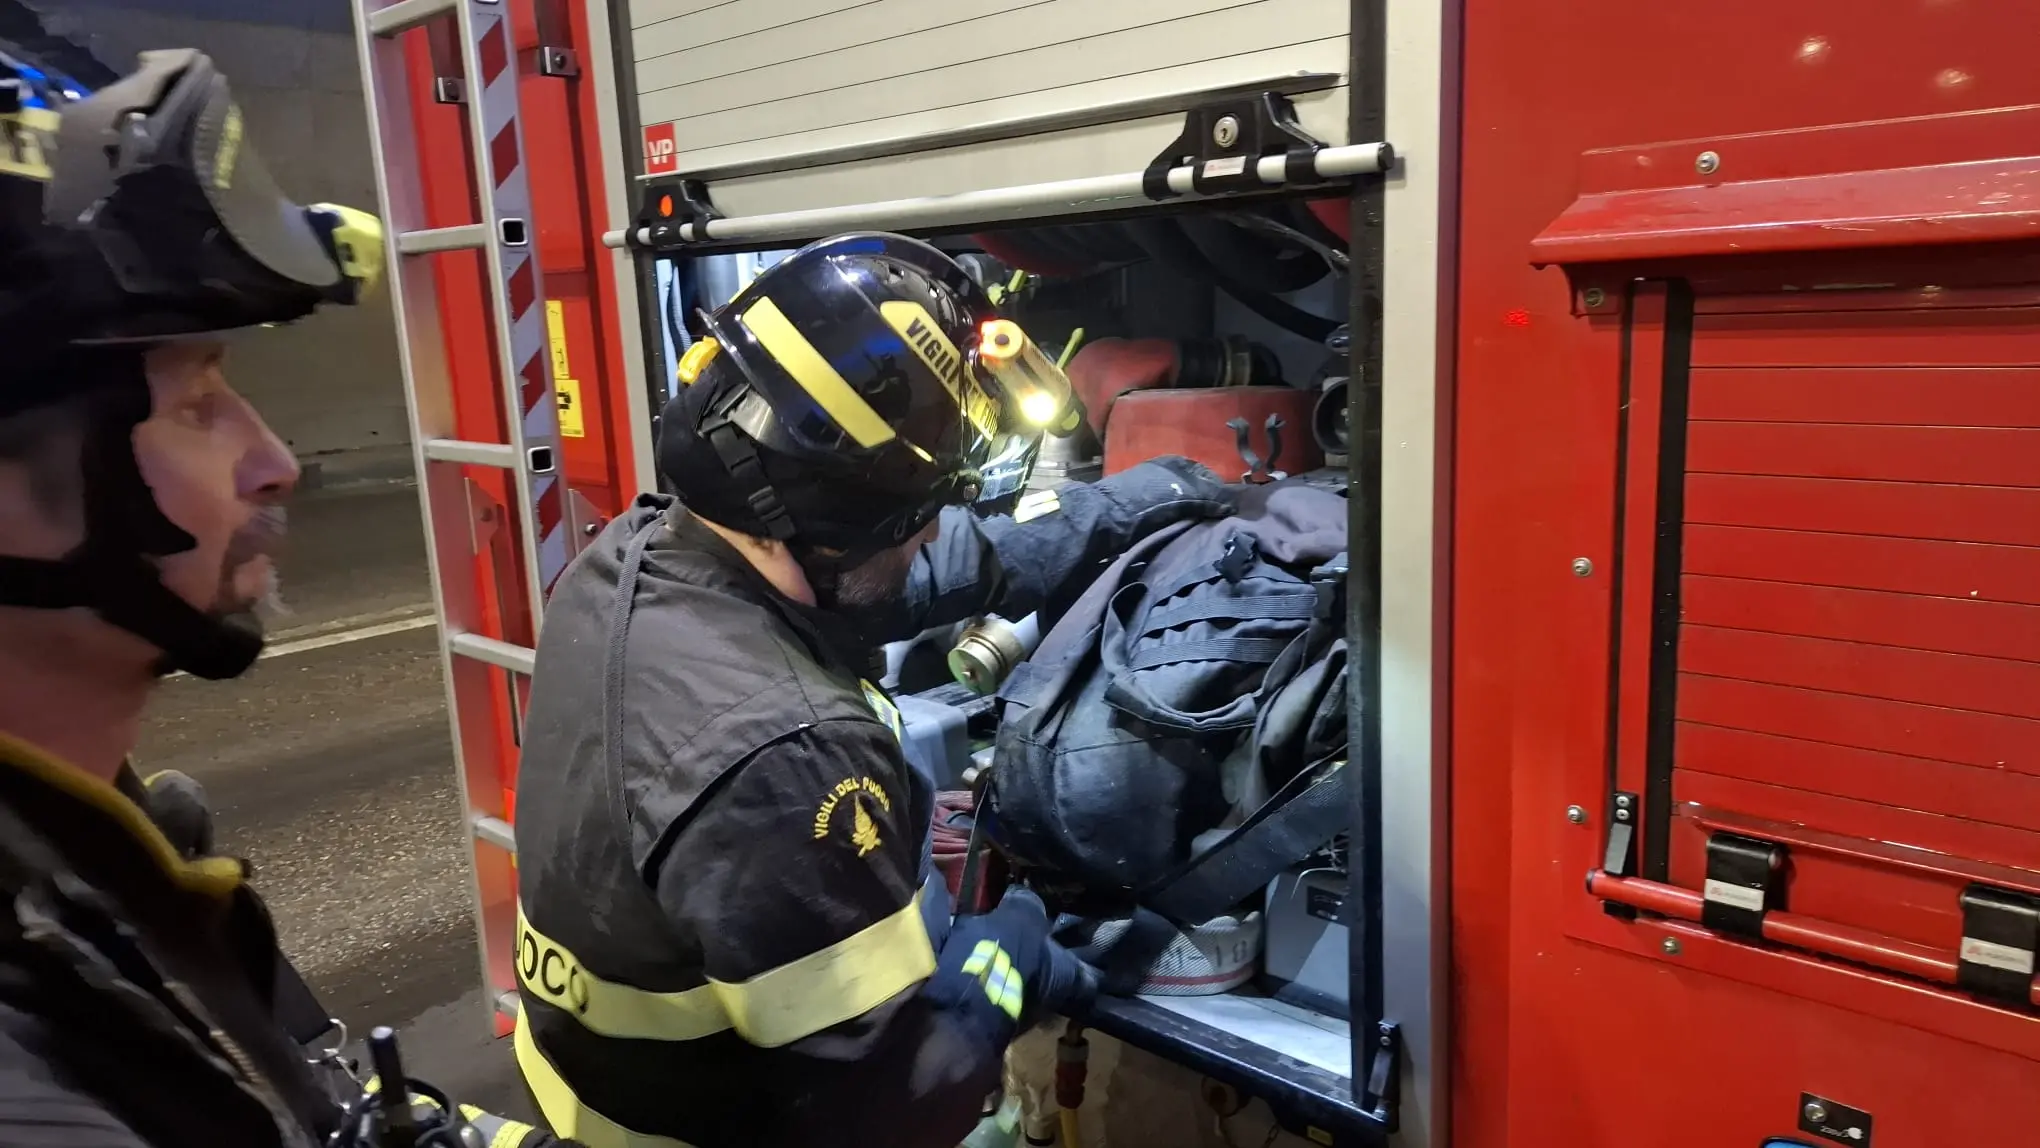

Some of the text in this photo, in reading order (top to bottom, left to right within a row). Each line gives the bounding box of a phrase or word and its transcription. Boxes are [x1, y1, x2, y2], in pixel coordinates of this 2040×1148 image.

[647, 138, 674, 165] VP
[813, 793, 839, 839] VIGILI
[834, 776, 861, 797] DEL
